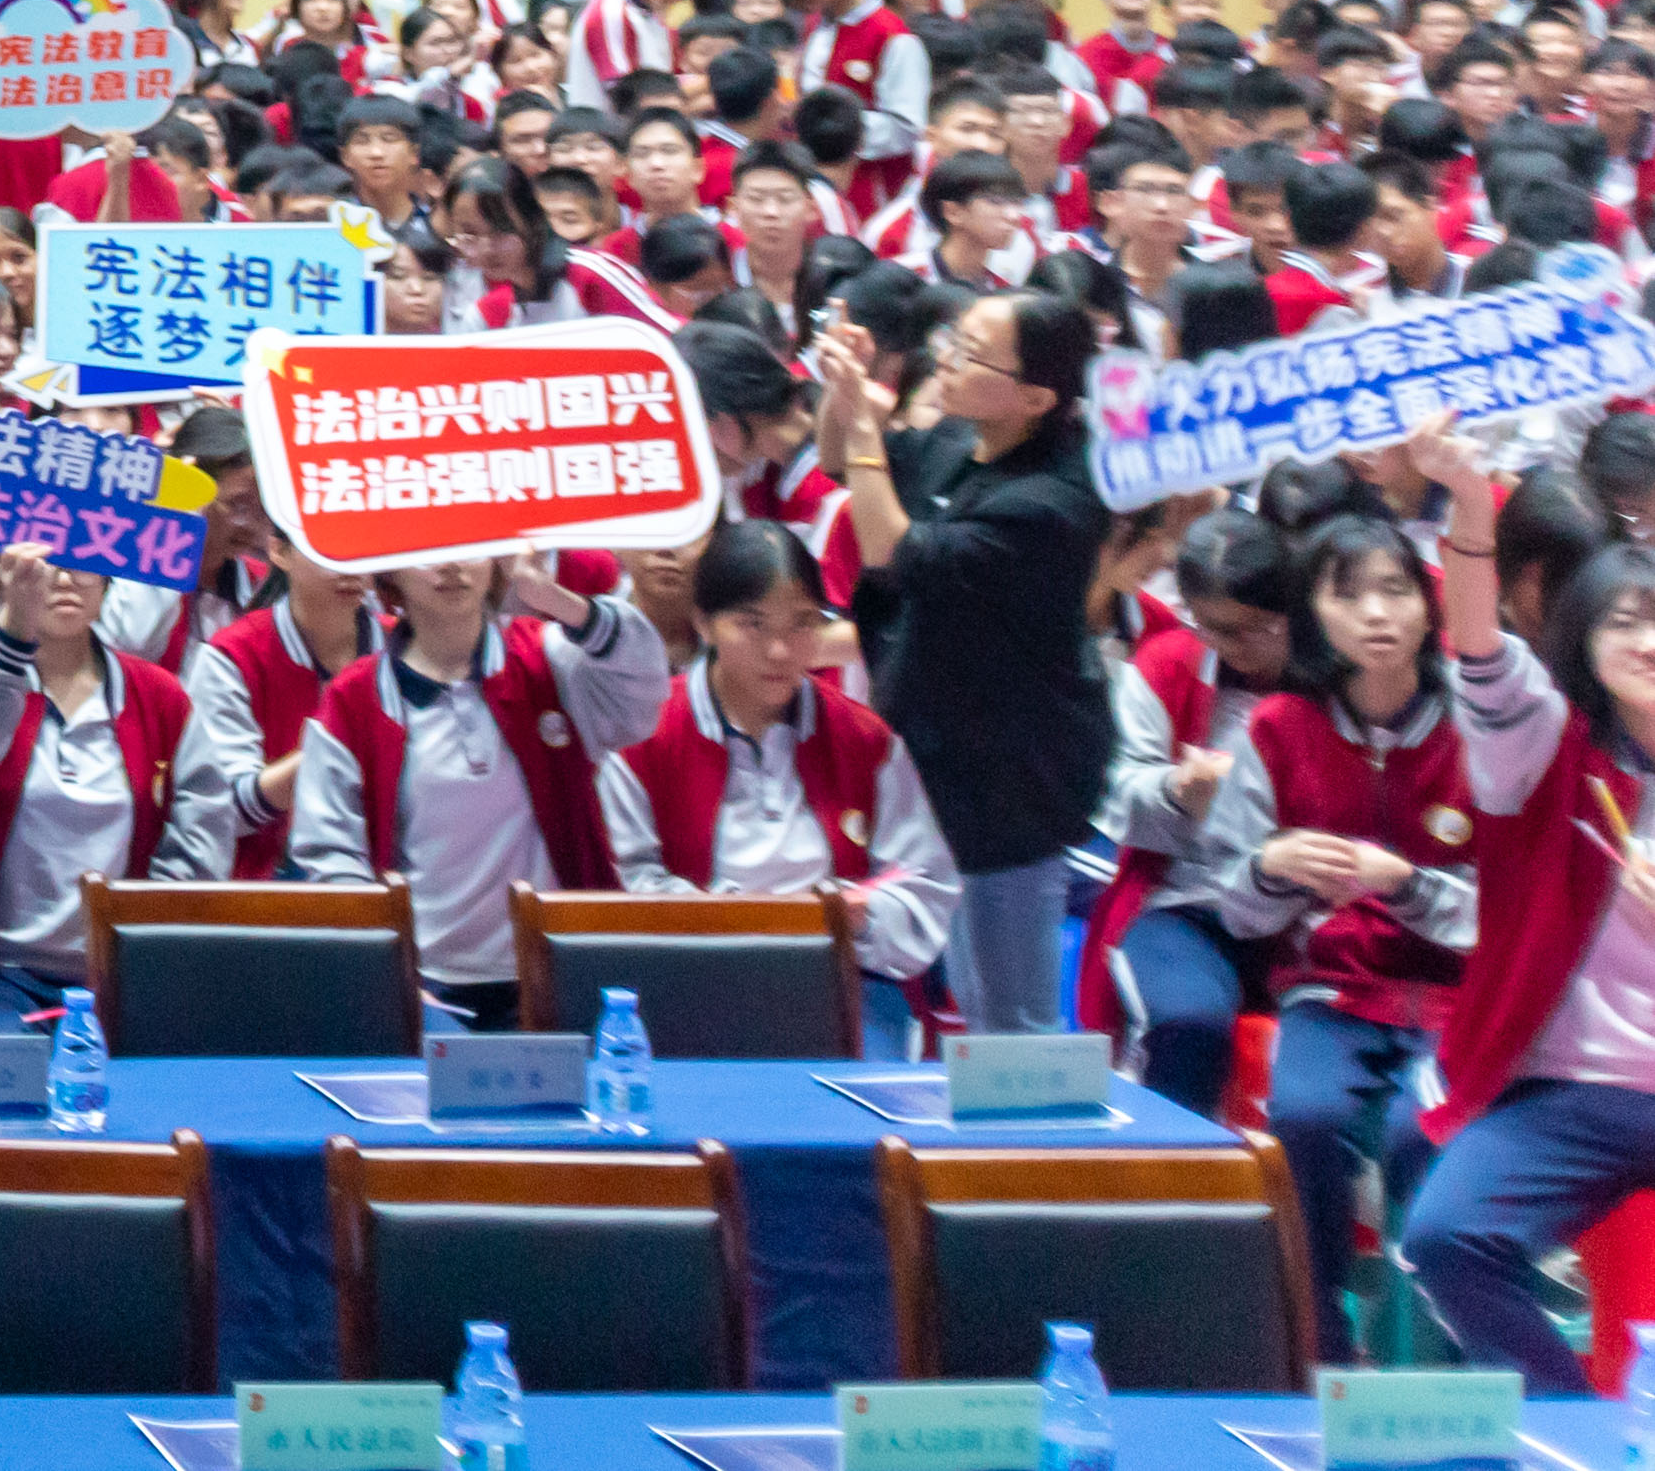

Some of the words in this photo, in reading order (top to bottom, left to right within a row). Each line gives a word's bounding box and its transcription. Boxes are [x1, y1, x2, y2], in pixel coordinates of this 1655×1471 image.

[84, 237, 341, 316] 宪法相伴
[292, 371, 675, 446] 法治兴则国兴
[299, 438, 684, 515] 法治强则国强
